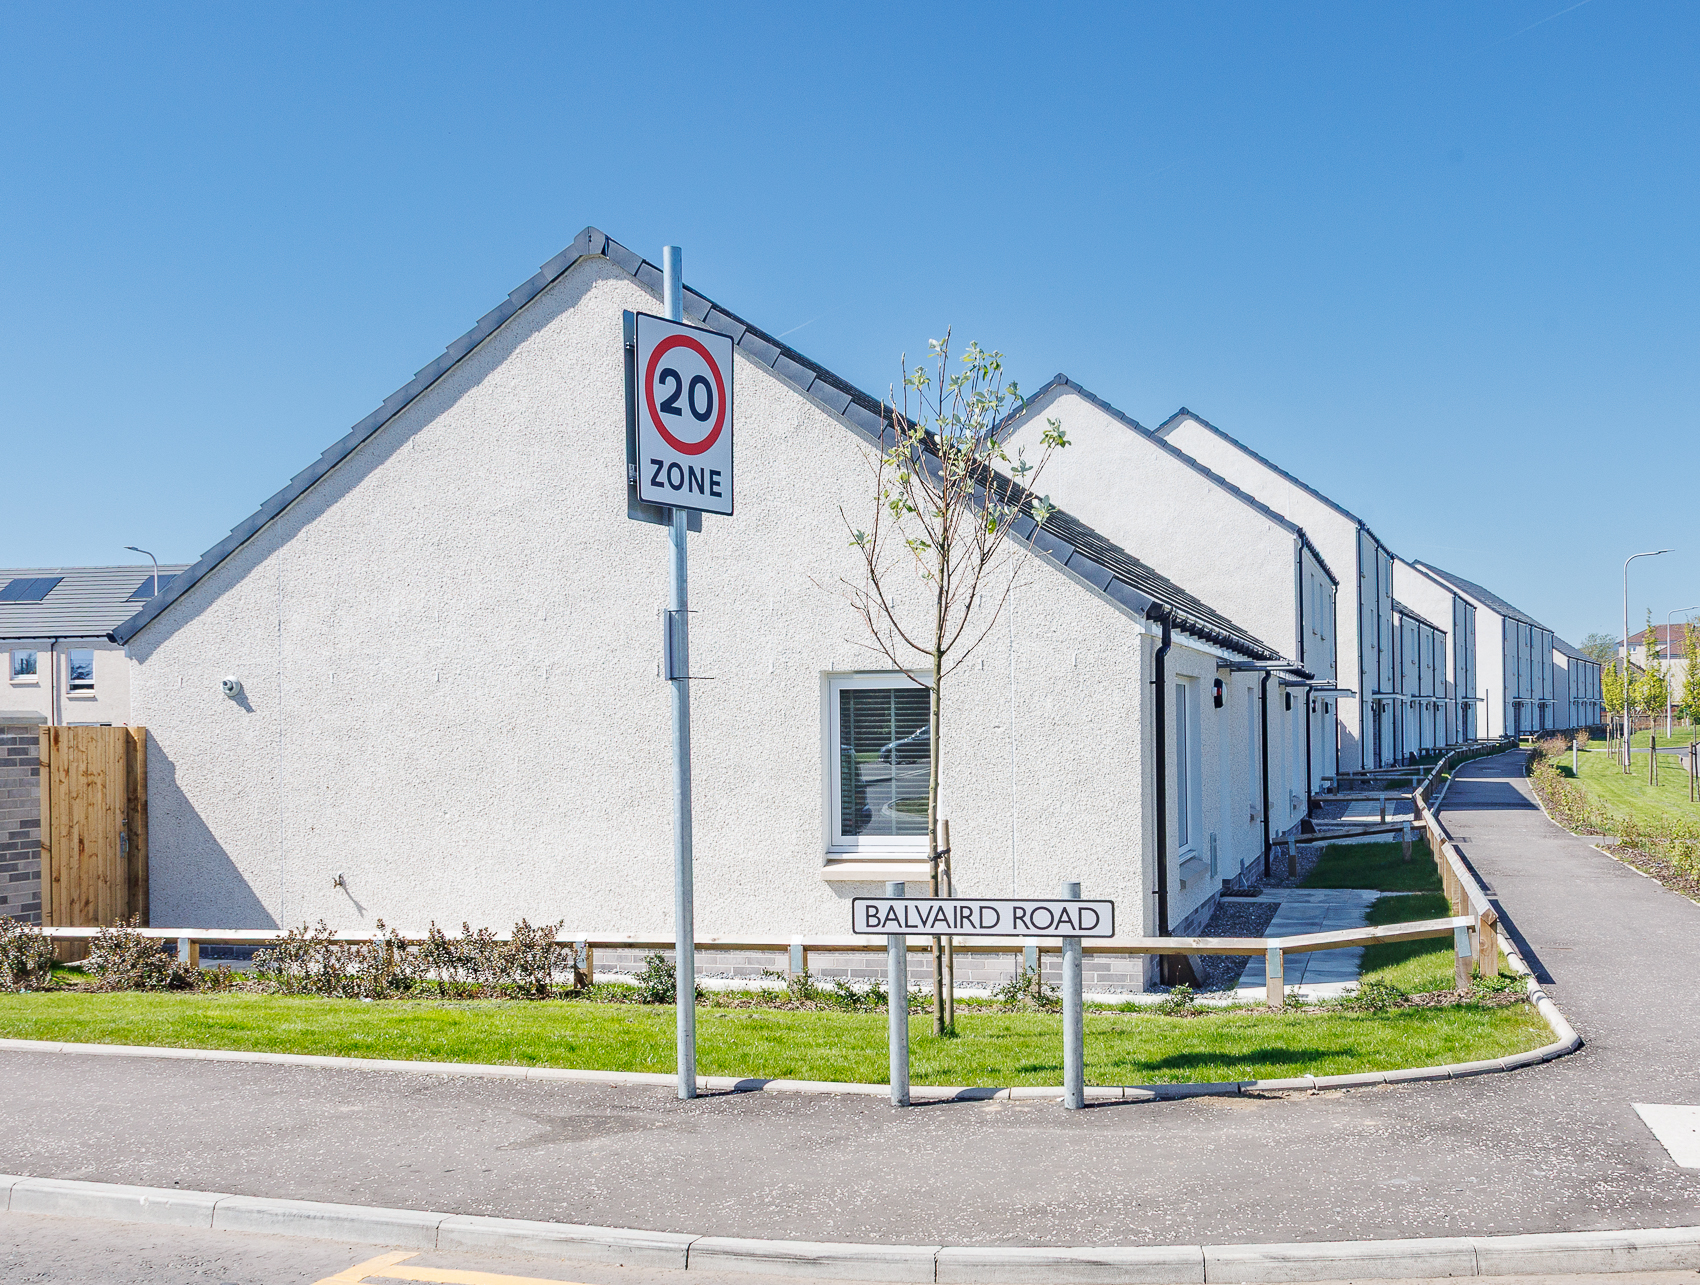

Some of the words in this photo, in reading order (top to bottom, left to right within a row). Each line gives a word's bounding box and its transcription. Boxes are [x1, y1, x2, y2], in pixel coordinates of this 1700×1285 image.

[659, 368, 714, 422] 20
[651, 458, 722, 498] ZONE
[866, 905, 1000, 929] BALVAIRD
[1013, 906, 1100, 931] ROAD
